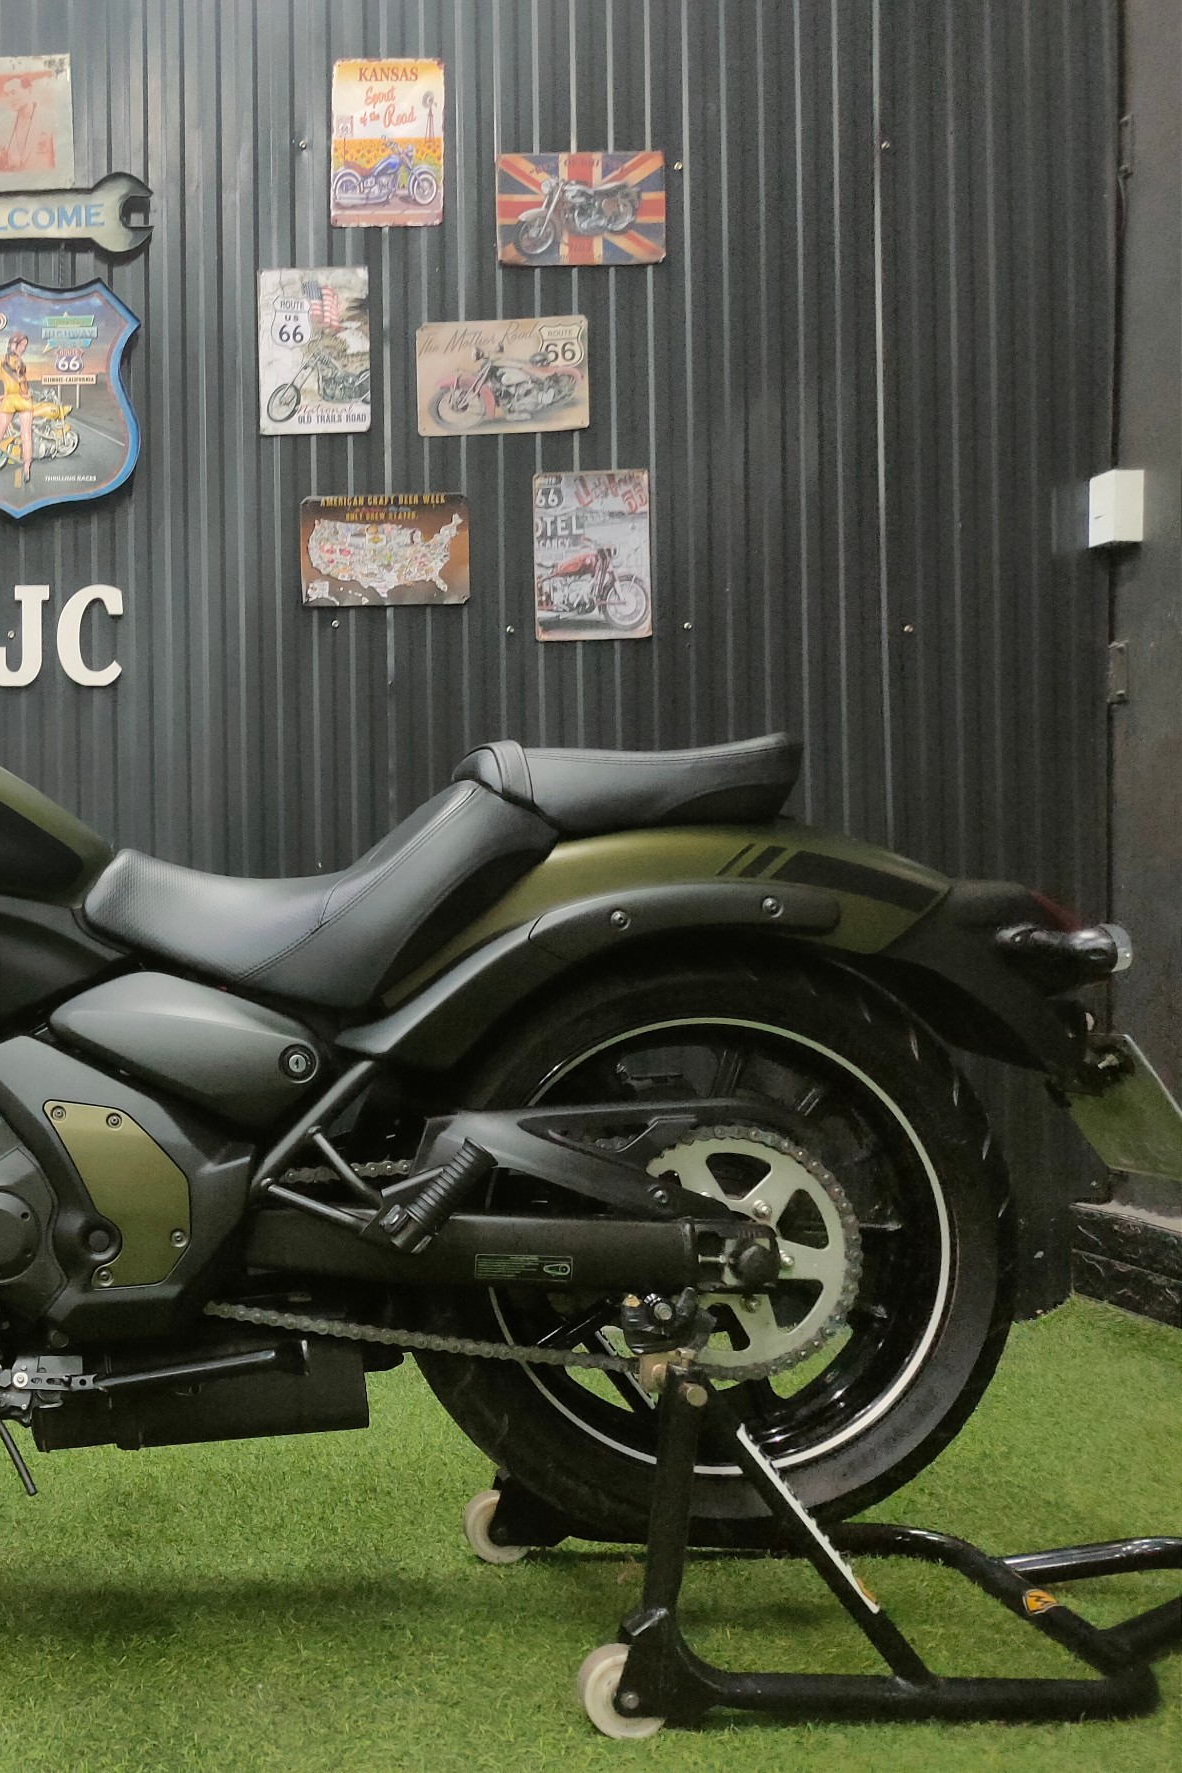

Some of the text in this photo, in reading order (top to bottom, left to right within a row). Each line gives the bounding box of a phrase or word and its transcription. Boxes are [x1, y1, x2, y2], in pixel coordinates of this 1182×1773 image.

[358, 67, 418, 82] KANSAS
[383, 104, 417, 128] Road
[280, 300, 305, 310] ROUTE
[278, 324, 304, 344] 66
[548, 329, 573, 337] ROUTE
[544, 341, 577, 363] 66
[58, 356, 80, 371] 66
[298, 415, 312, 424] OLD
[346, 413, 367, 423] ROAD
[320, 496, 365, 507] AMERICAN
[536, 488, 558, 507] 66
